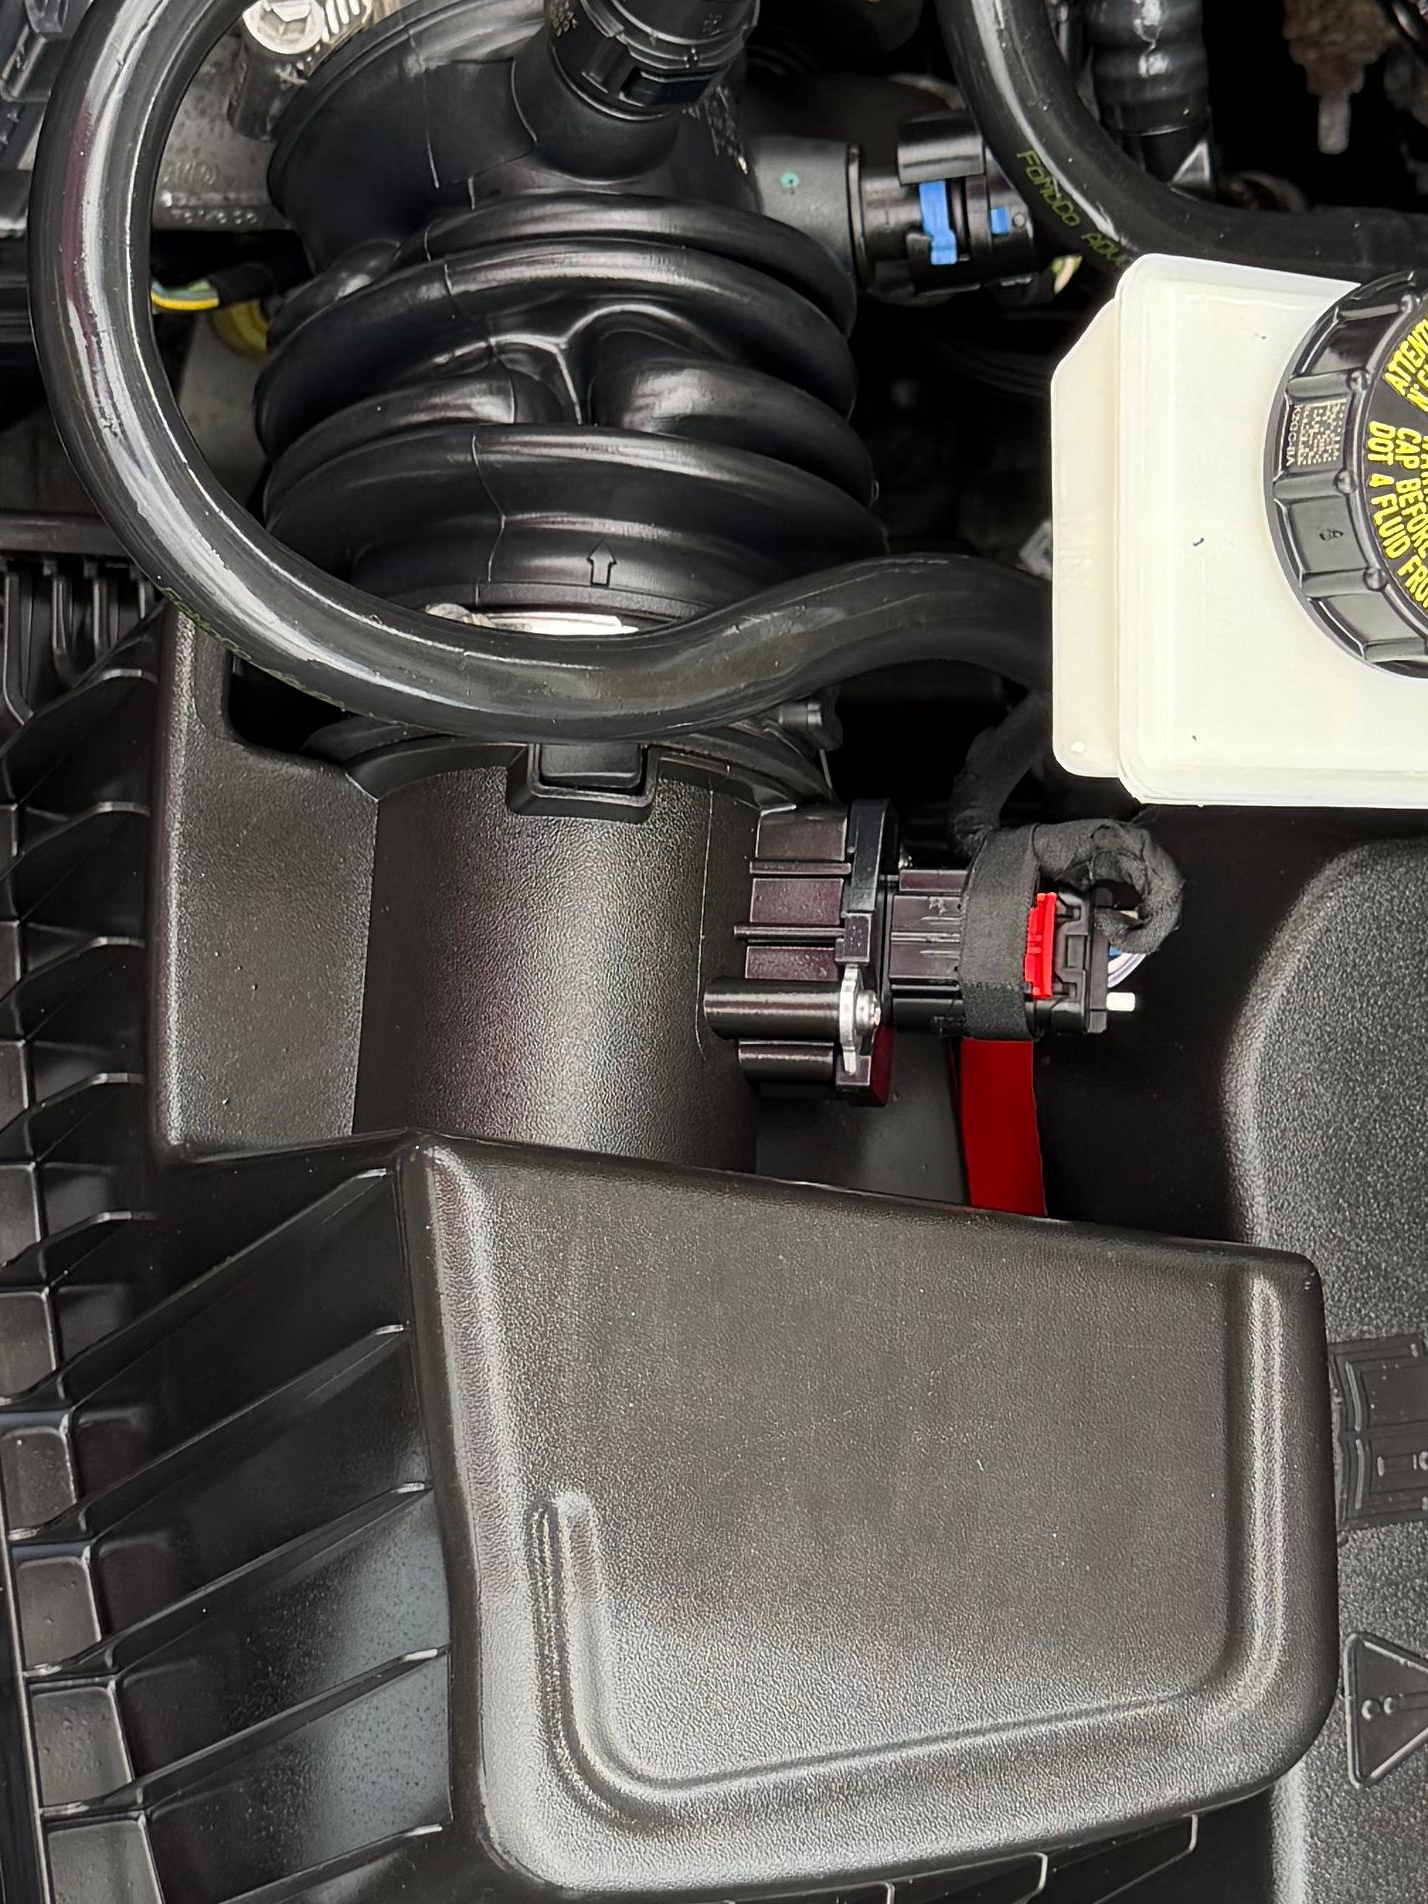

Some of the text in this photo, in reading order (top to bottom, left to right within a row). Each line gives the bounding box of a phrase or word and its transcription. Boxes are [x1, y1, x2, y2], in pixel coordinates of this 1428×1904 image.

[1368, 421, 1394, 465] DOT
[1394, 428, 1422, 469] CAP
[1369, 471, 1393, 488] 4
[1371, 492, 1411, 559] FLUID
